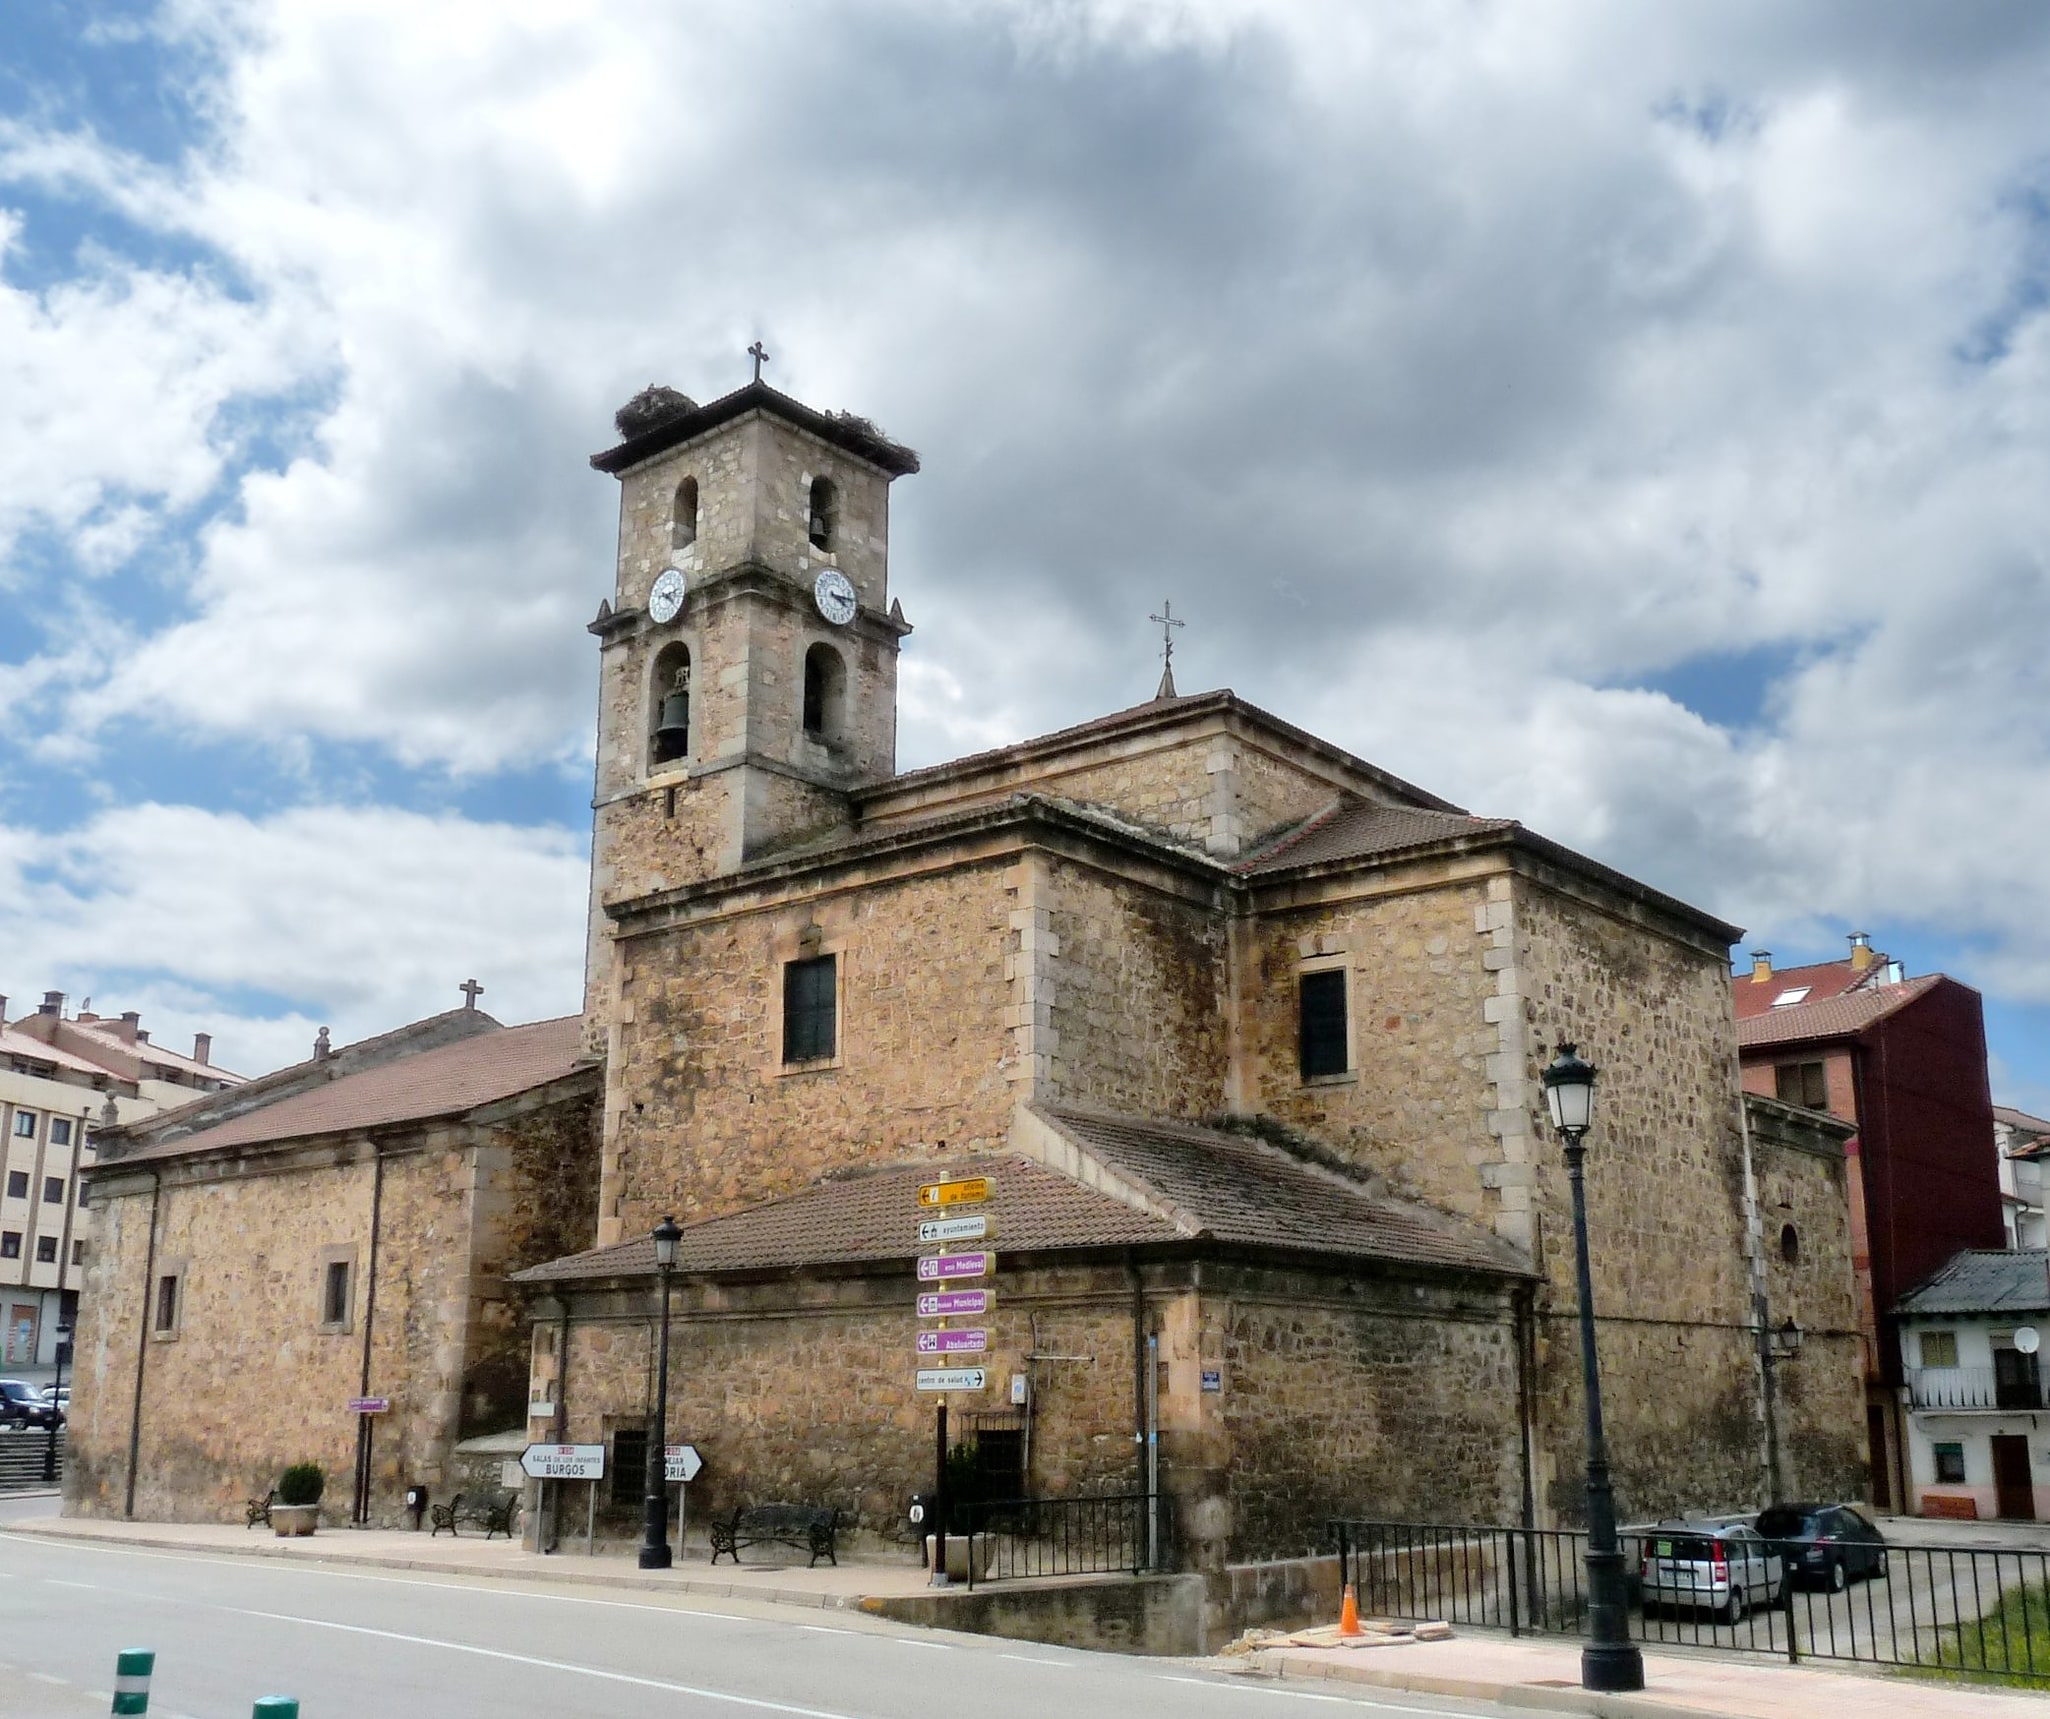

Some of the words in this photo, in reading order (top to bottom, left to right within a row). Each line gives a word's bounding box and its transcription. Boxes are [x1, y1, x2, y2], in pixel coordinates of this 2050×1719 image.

[963, 1182, 984, 1191] oficina
[950, 1193, 958, 1201] de
[960, 1190, 984, 1200] turismo
[943, 1222, 984, 1235] ayuntamiento
[956, 1259, 984, 1271] Medieval
[953, 1296, 984, 1309] Municipal
[918, 1376, 936, 1384] centro
[938, 1376, 945, 1384] de
[947, 1376, 963, 1384] salud
[532, 1455, 552, 1463] SALAS
[563, 1456, 573, 1464] LOS
[575, 1456, 601, 1464] INFANTES
[545, 1463, 585, 1476] BURGOS
[664, 1466, 687, 1479] ORIA
